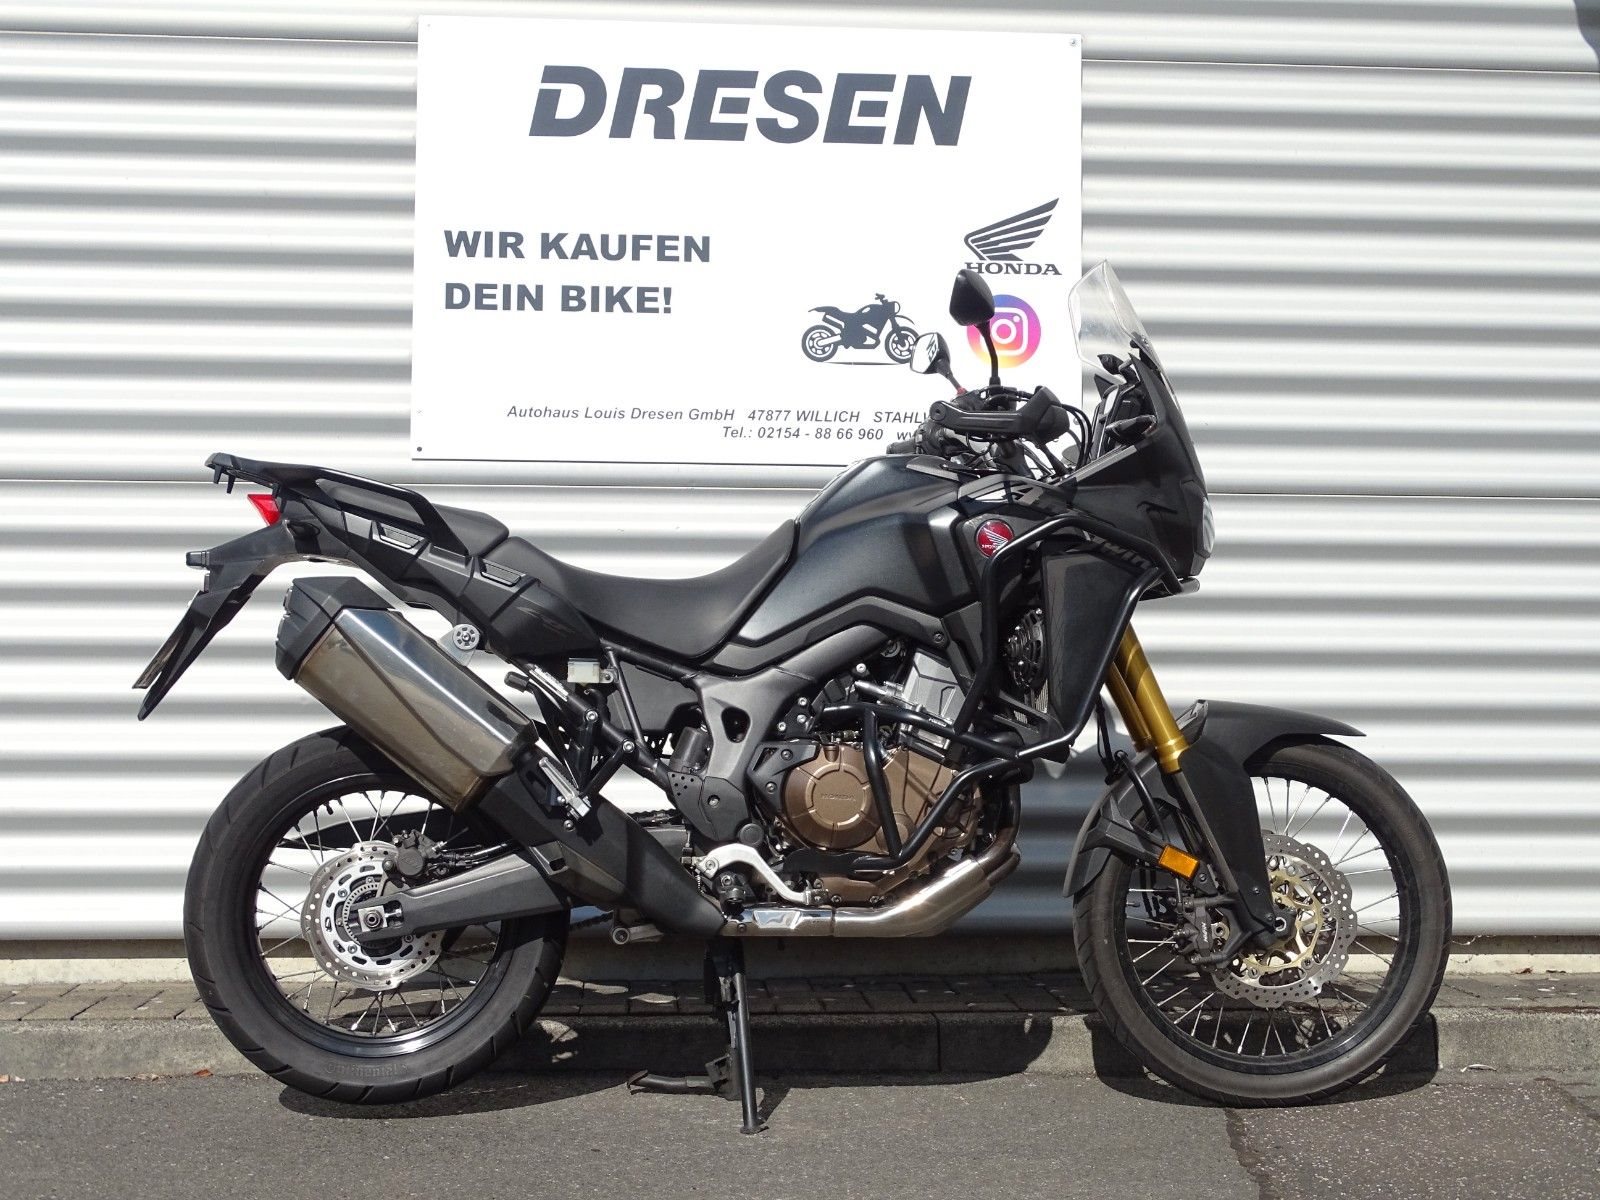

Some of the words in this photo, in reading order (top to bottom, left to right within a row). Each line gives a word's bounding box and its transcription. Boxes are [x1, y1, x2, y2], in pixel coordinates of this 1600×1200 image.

[528, 65, 972, 147] DRESEN
[443, 230, 525, 259] WIR
[540, 232, 710, 263] KAUFEN
[964, 262, 1063, 276] HONDA
[445, 282, 544, 311] DEIN
[561, 285, 673, 314] BIKE!
[507, 405, 579, 419] Autohaus
[584, 407, 625, 420] Louis
[630, 407, 683, 420] Dresen
[688, 408, 735, 421] GmbH
[747, 409, 792, 422] 47877
[796, 410, 860, 423] WILLICH
[722, 426, 752, 439] Tel.:
[757, 426, 801, 439] 02154
[814, 428, 832, 440] 88
[836, 428, 854, 440] 66
[858, 428, 884, 440] 960
[896, 431, 913, 441] w
